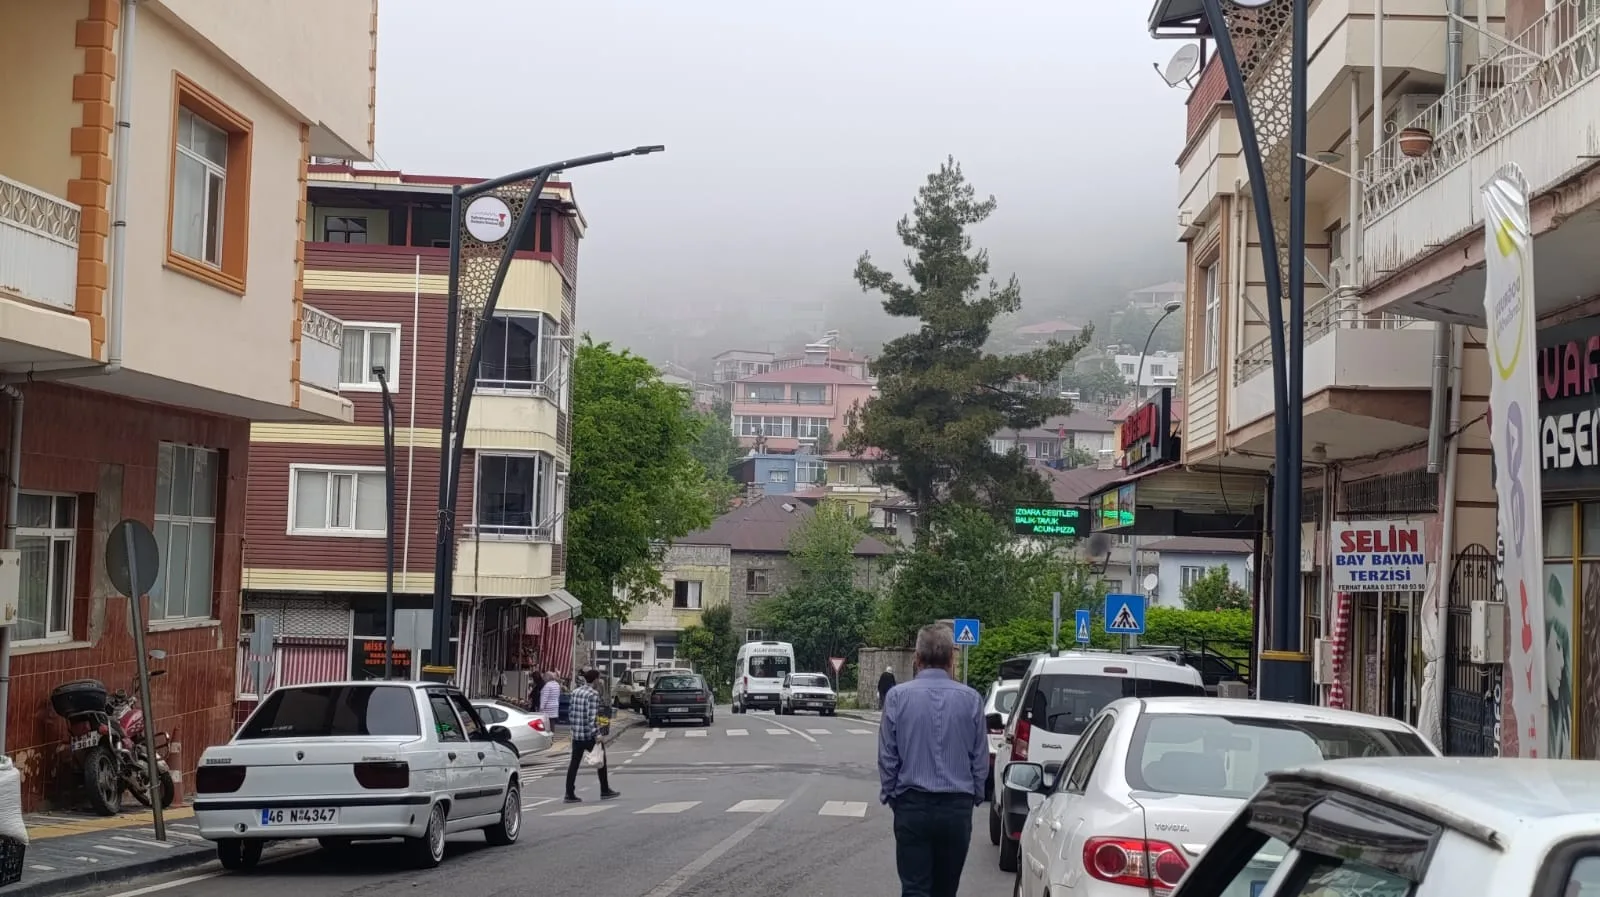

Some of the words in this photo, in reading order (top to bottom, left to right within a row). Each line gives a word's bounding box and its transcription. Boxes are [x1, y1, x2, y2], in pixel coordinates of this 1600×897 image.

[1538, 335, 1600, 400] UAF
[1340, 525, 1418, 552] SELİN
[1336, 555, 1366, 566] BAY
[1371, 553, 1424, 566] BAYAN
[1349, 566, 1411, 581] TERZİSİ
[268, 810, 284, 823] 46
[290, 810, 298, 822] N
[303, 808, 336, 822] 4347
[1154, 823, 1190, 833] TOYOTA
